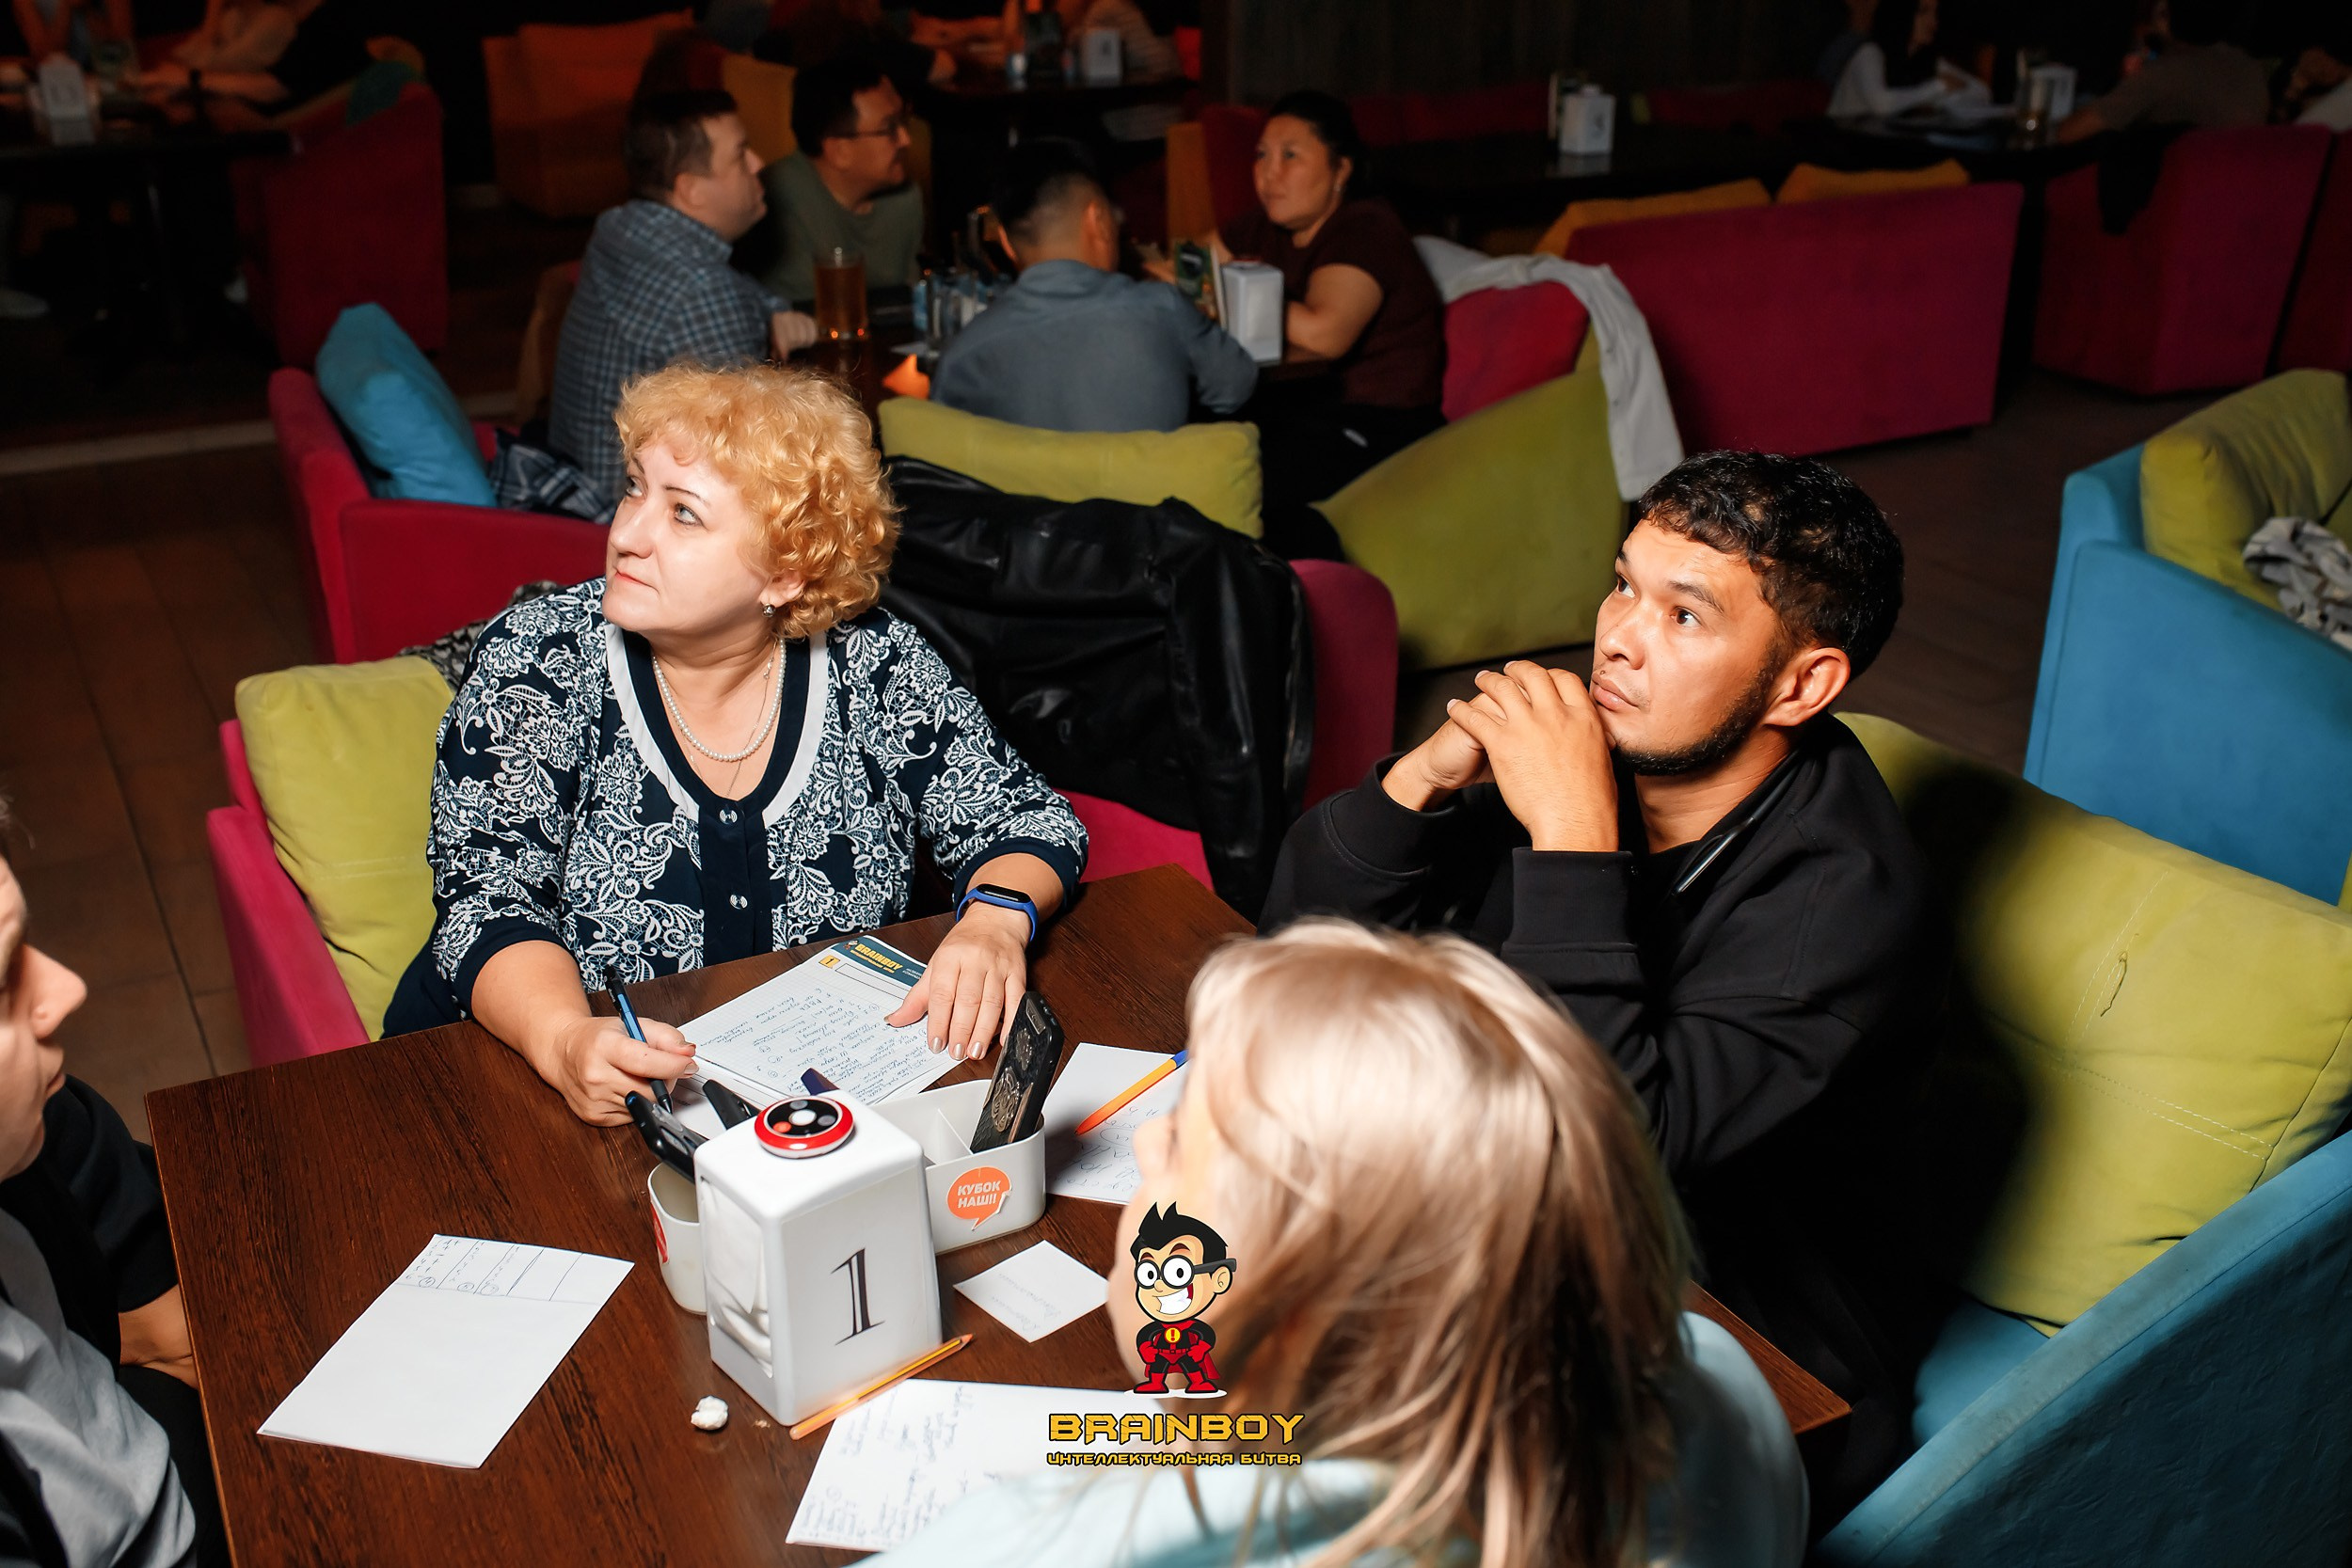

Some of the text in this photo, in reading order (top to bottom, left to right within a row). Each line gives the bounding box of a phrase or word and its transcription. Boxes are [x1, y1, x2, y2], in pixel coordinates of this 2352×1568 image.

[854, 943, 903, 971] BRAINBOY
[957, 1180, 1001, 1196] КУБОК
[830, 1247, 886, 1347] 1
